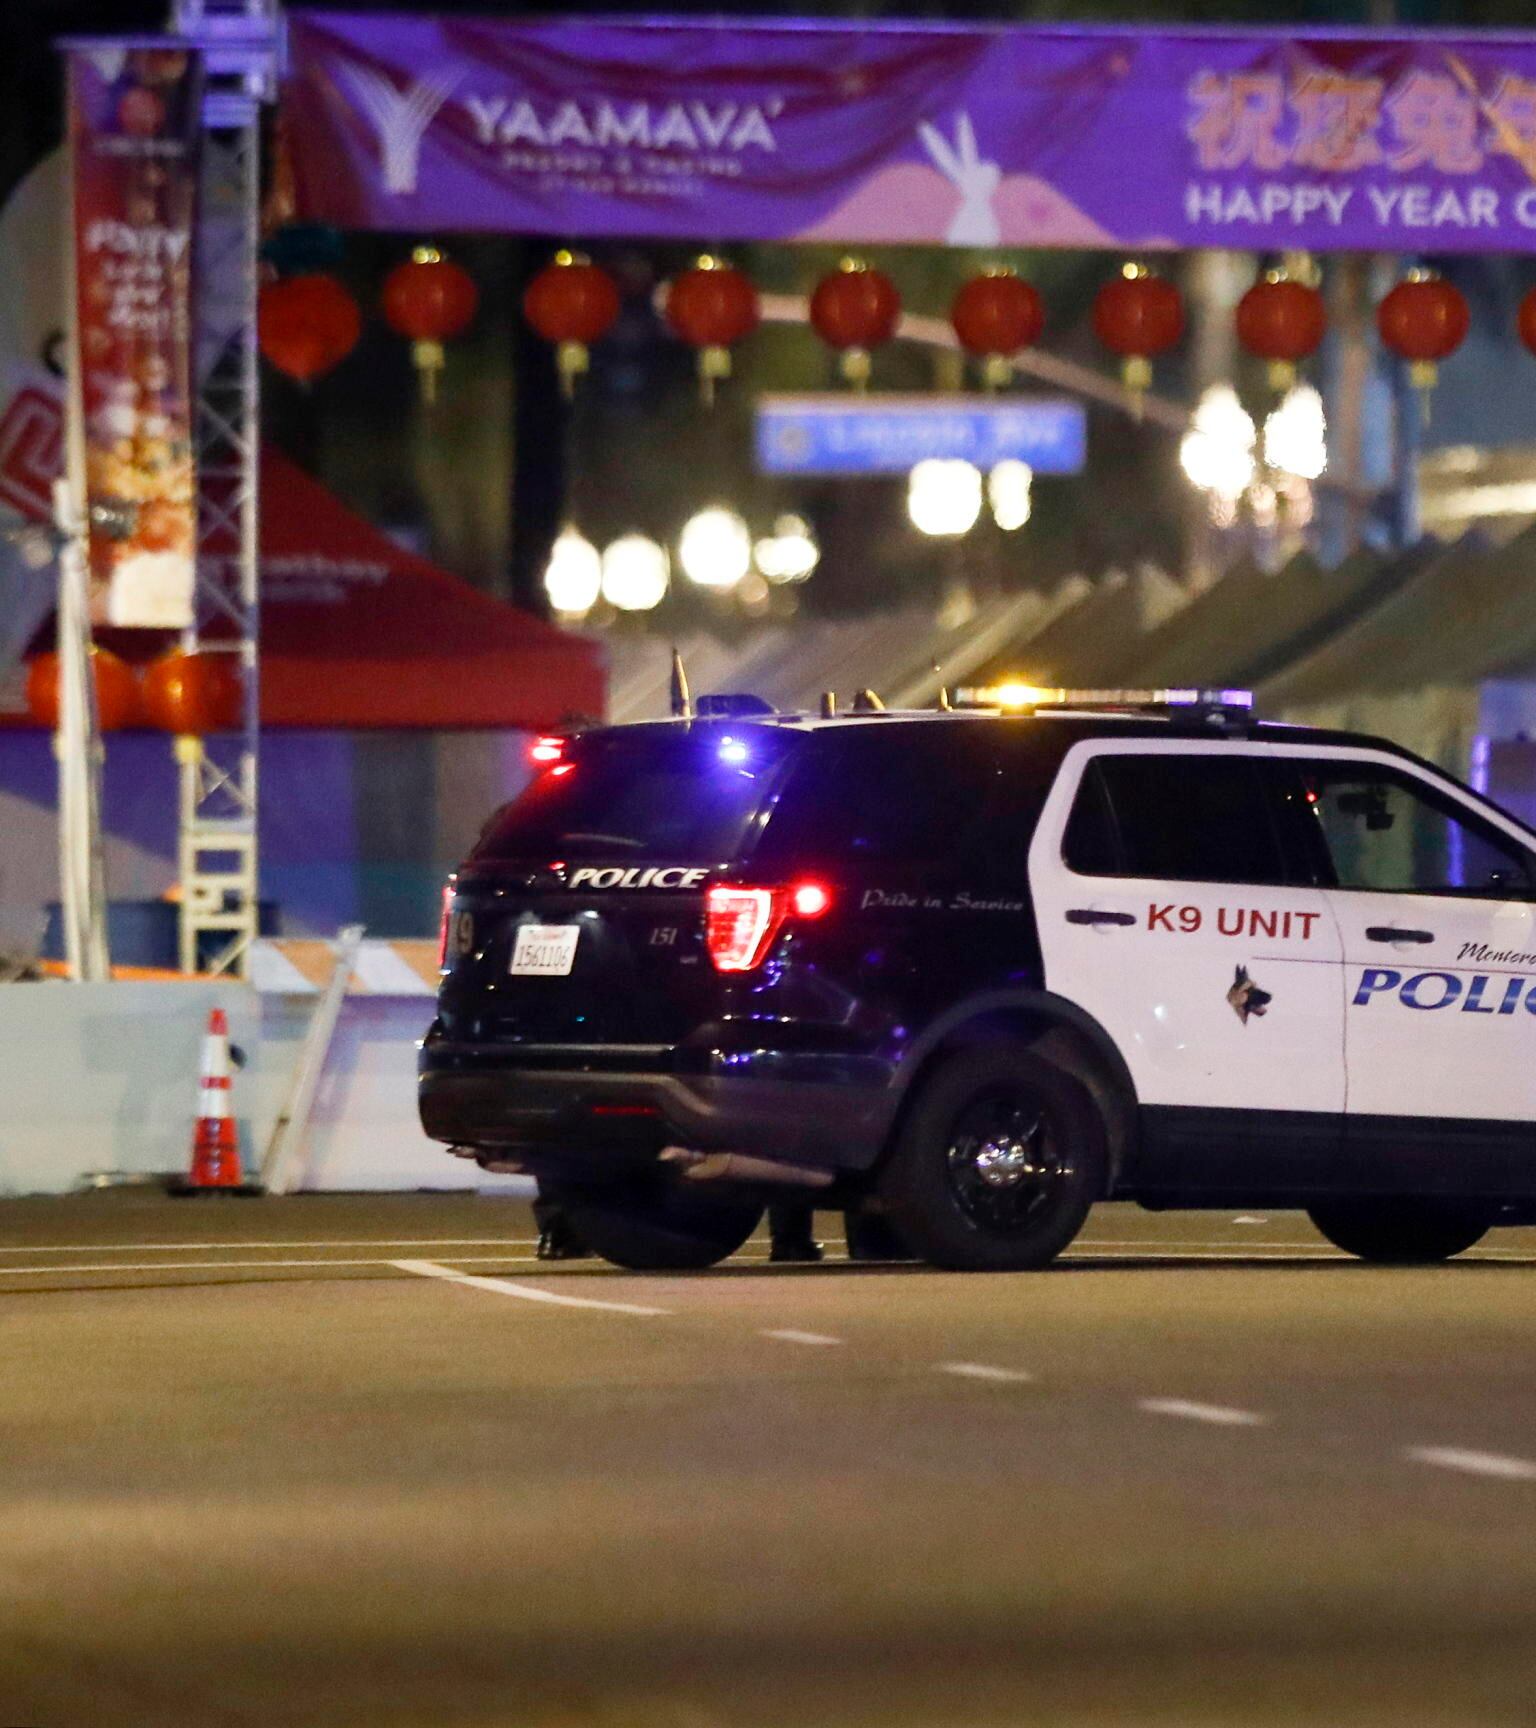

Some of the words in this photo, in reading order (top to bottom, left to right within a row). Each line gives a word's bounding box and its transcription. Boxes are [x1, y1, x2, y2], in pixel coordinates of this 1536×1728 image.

[1185, 185, 1353, 226] HAPPY
[1368, 186, 1500, 228] YEAR
[568, 868, 710, 889] POLICE
[861, 888, 917, 909] Pride
[924, 898, 941, 908] in
[950, 892, 1024, 911] Service
[1148, 903, 1203, 934] K9
[1217, 907, 1321, 940] UNIT
[650, 927, 678, 946] 151
